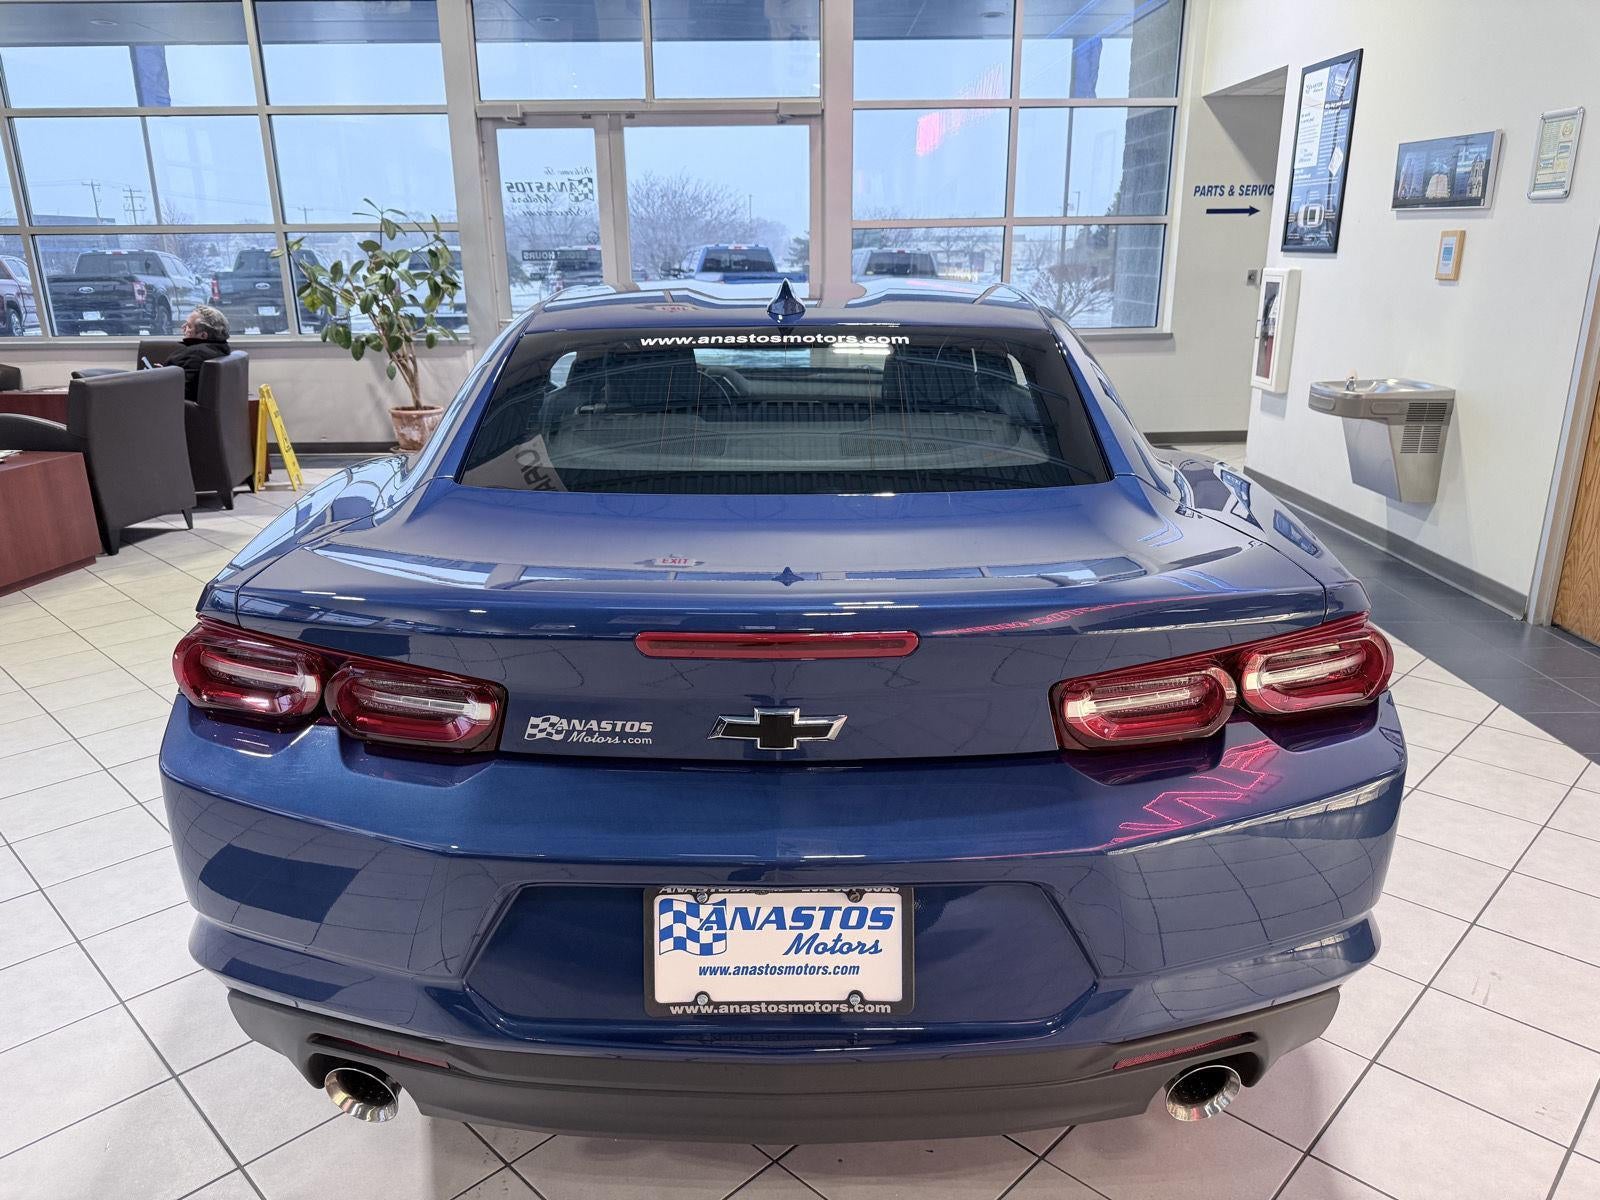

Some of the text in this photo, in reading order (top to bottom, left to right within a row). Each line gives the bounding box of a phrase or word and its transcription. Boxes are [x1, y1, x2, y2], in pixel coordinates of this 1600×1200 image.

[1193, 185, 1225, 197] PARTS
[1228, 185, 1235, 196] &
[640, 333, 910, 346] www.anastosmotors.com
[554, 718, 653, 733] ANASTOS
[697, 906, 896, 931] ANASTOS
[782, 932, 883, 956] Motors
[698, 963, 860, 976] www.anastosmotors.com
[669, 1002, 891, 1015] www.anastosmotors.com
